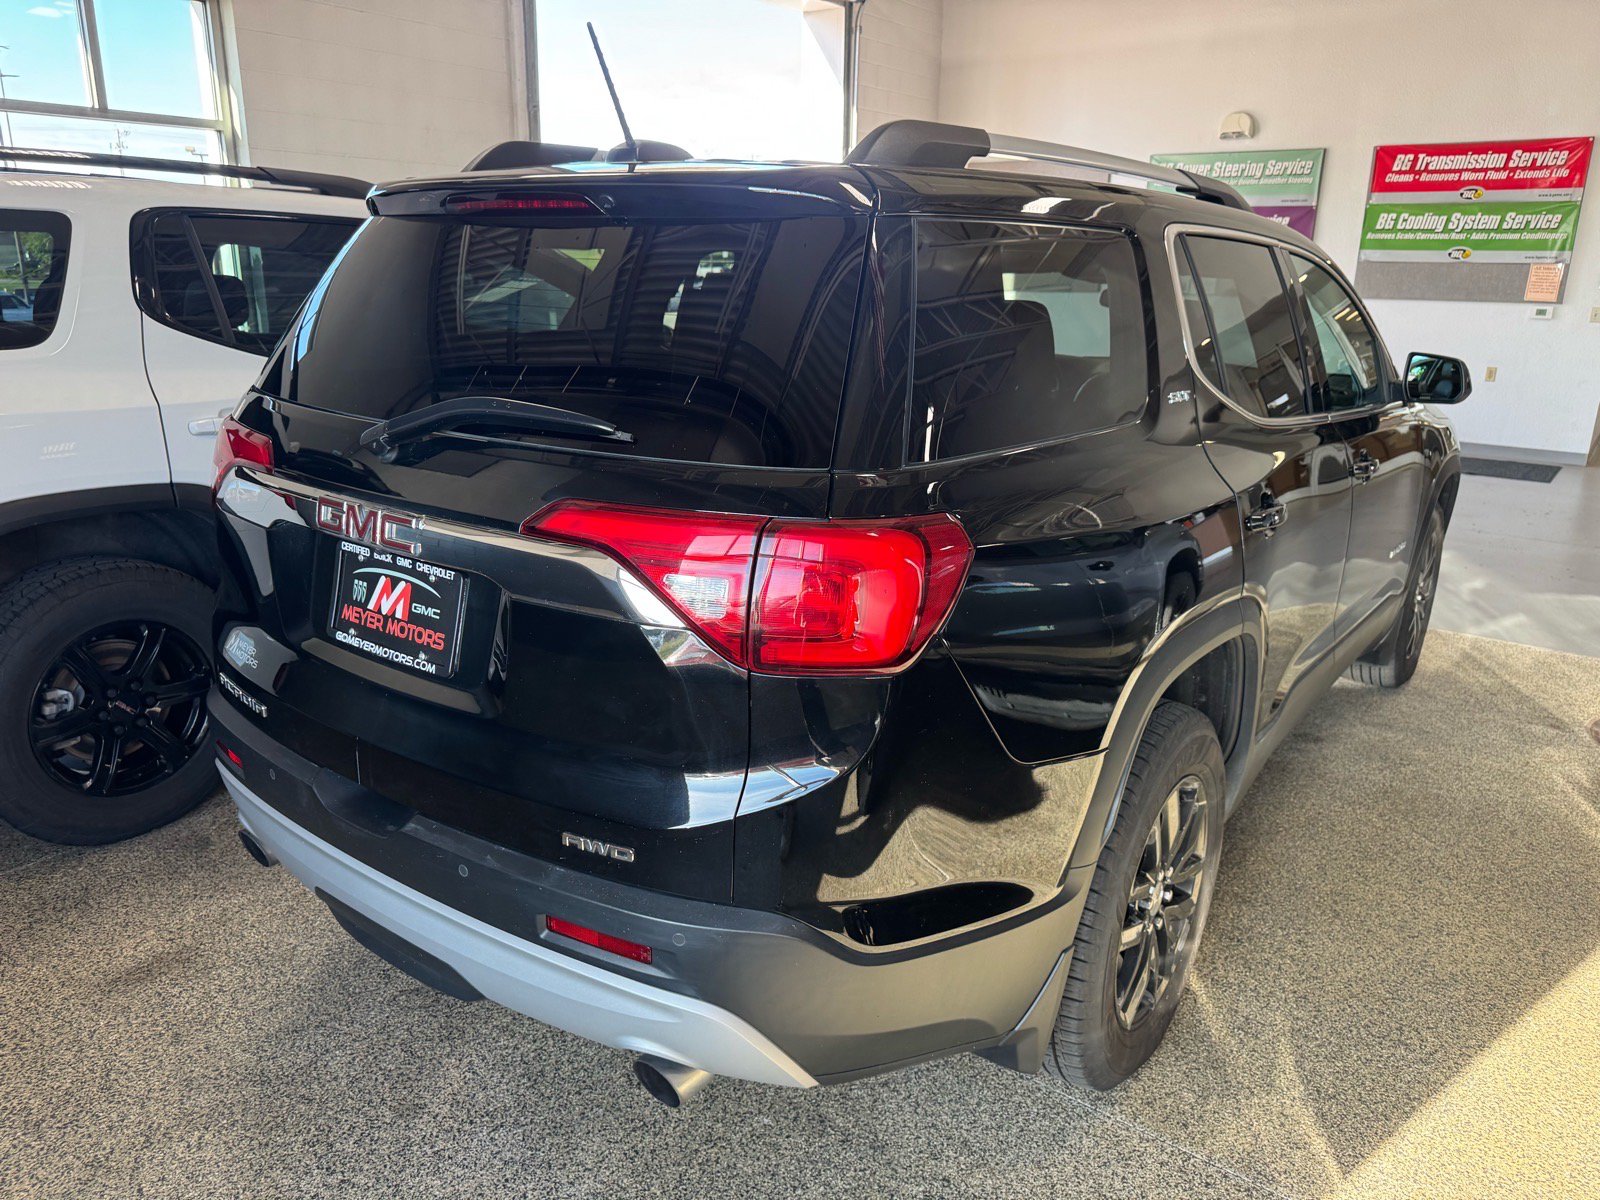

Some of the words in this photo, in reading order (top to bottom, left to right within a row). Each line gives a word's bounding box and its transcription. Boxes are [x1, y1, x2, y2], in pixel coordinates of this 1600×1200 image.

[1212, 160, 1264, 179] Steering
[1265, 158, 1314, 176] Service
[1392, 154, 1415, 172] BG
[1415, 151, 1506, 170] Transmission
[1508, 148, 1570, 168] Service
[1385, 172, 1414, 183] Cleans
[1419, 171, 1459, 182] Removes
[1460, 171, 1485, 181] Worn
[1485, 170, 1508, 180] Fluid
[1514, 169, 1550, 180] Extends
[1551, 168, 1570, 178] Life
[1375, 212, 1396, 230] BG
[1397, 211, 1448, 232] Cooling
[1449, 212, 1501, 233] System
[1502, 211, 1563, 230] Service
[1366, 231, 1395, 240] Removes
[1470, 231, 1488, 240] Adds
[1489, 231, 1520, 240] Premium
[1521, 231, 1568, 240] Conditioners
[316, 496, 423, 556] GMC
[341, 541, 370, 557] CERTIFIED
[396, 556, 412, 569] GMC
[416, 562, 456, 580] CHEVROLET
[411, 603, 440, 619] GMC
[341, 604, 383, 632] MEYER
[385, 618, 446, 651] MOTORS
[236, 648, 258, 669] MOTORS
[239, 641, 257, 657] MEYER
[335, 631, 436, 674] GOMEYERMOTORS.COM
[562, 832, 635, 862] AWD
